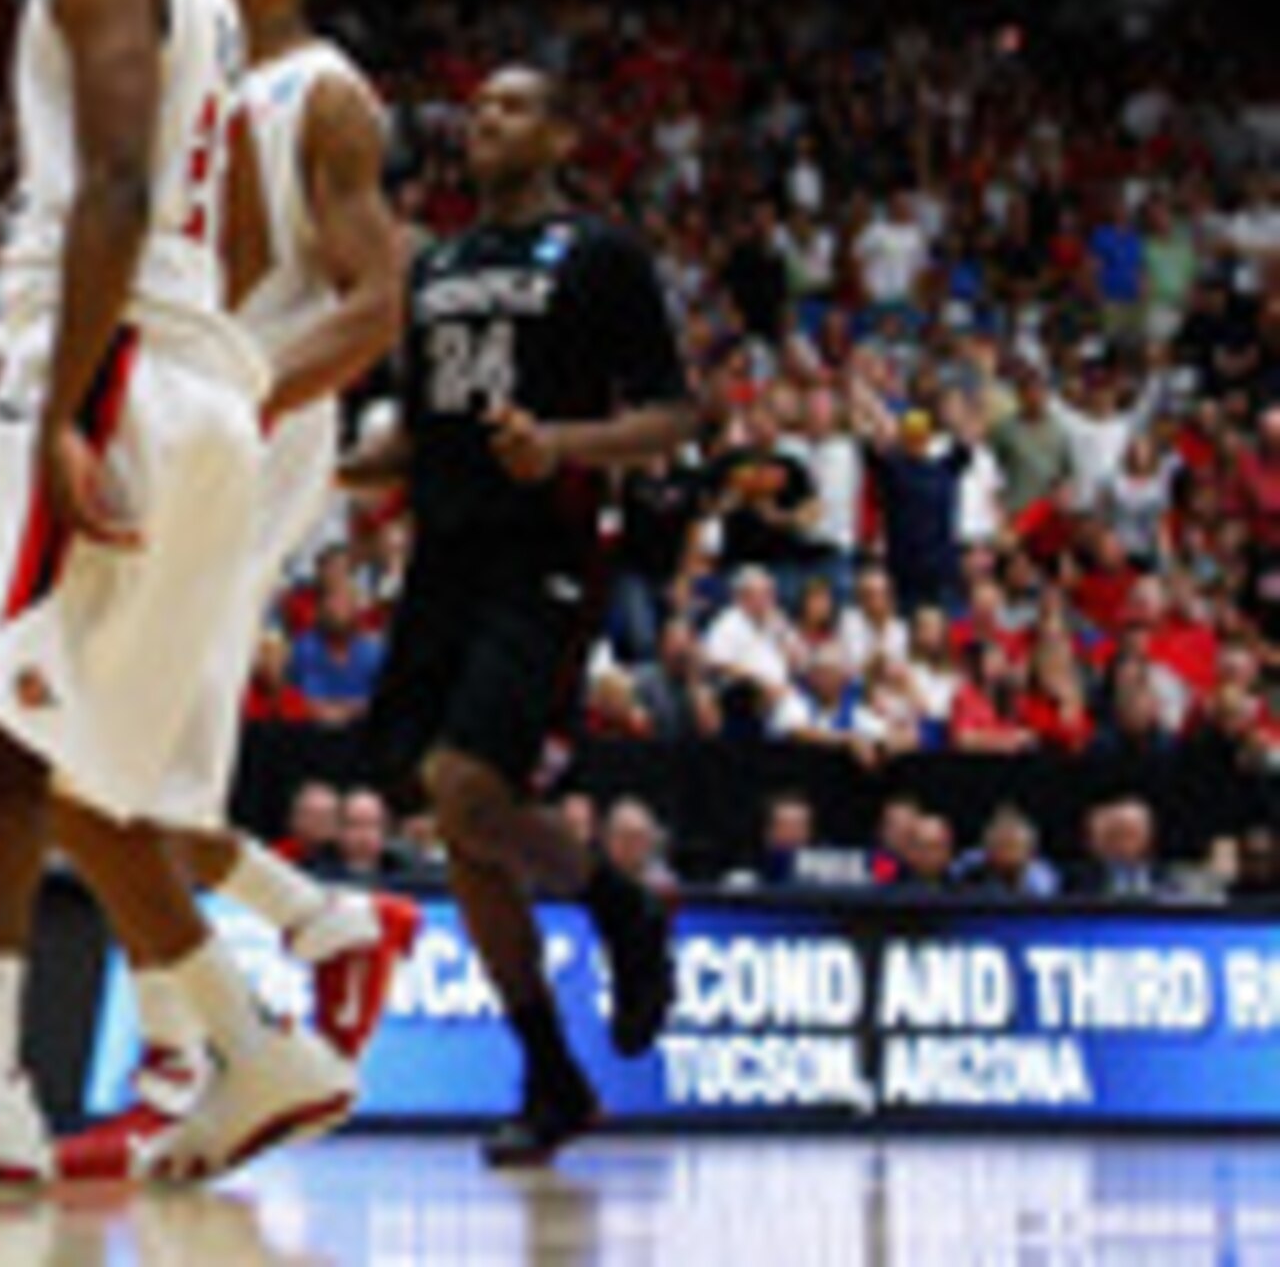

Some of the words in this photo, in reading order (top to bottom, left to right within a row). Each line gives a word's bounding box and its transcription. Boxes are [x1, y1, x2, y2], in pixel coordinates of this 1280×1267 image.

[879, 940, 1013, 1031] AND
[1026, 944, 1210, 1032] THIRD
[1224, 947, 1280, 1032] R
[883, 1035, 1096, 1107] ARIZONA
